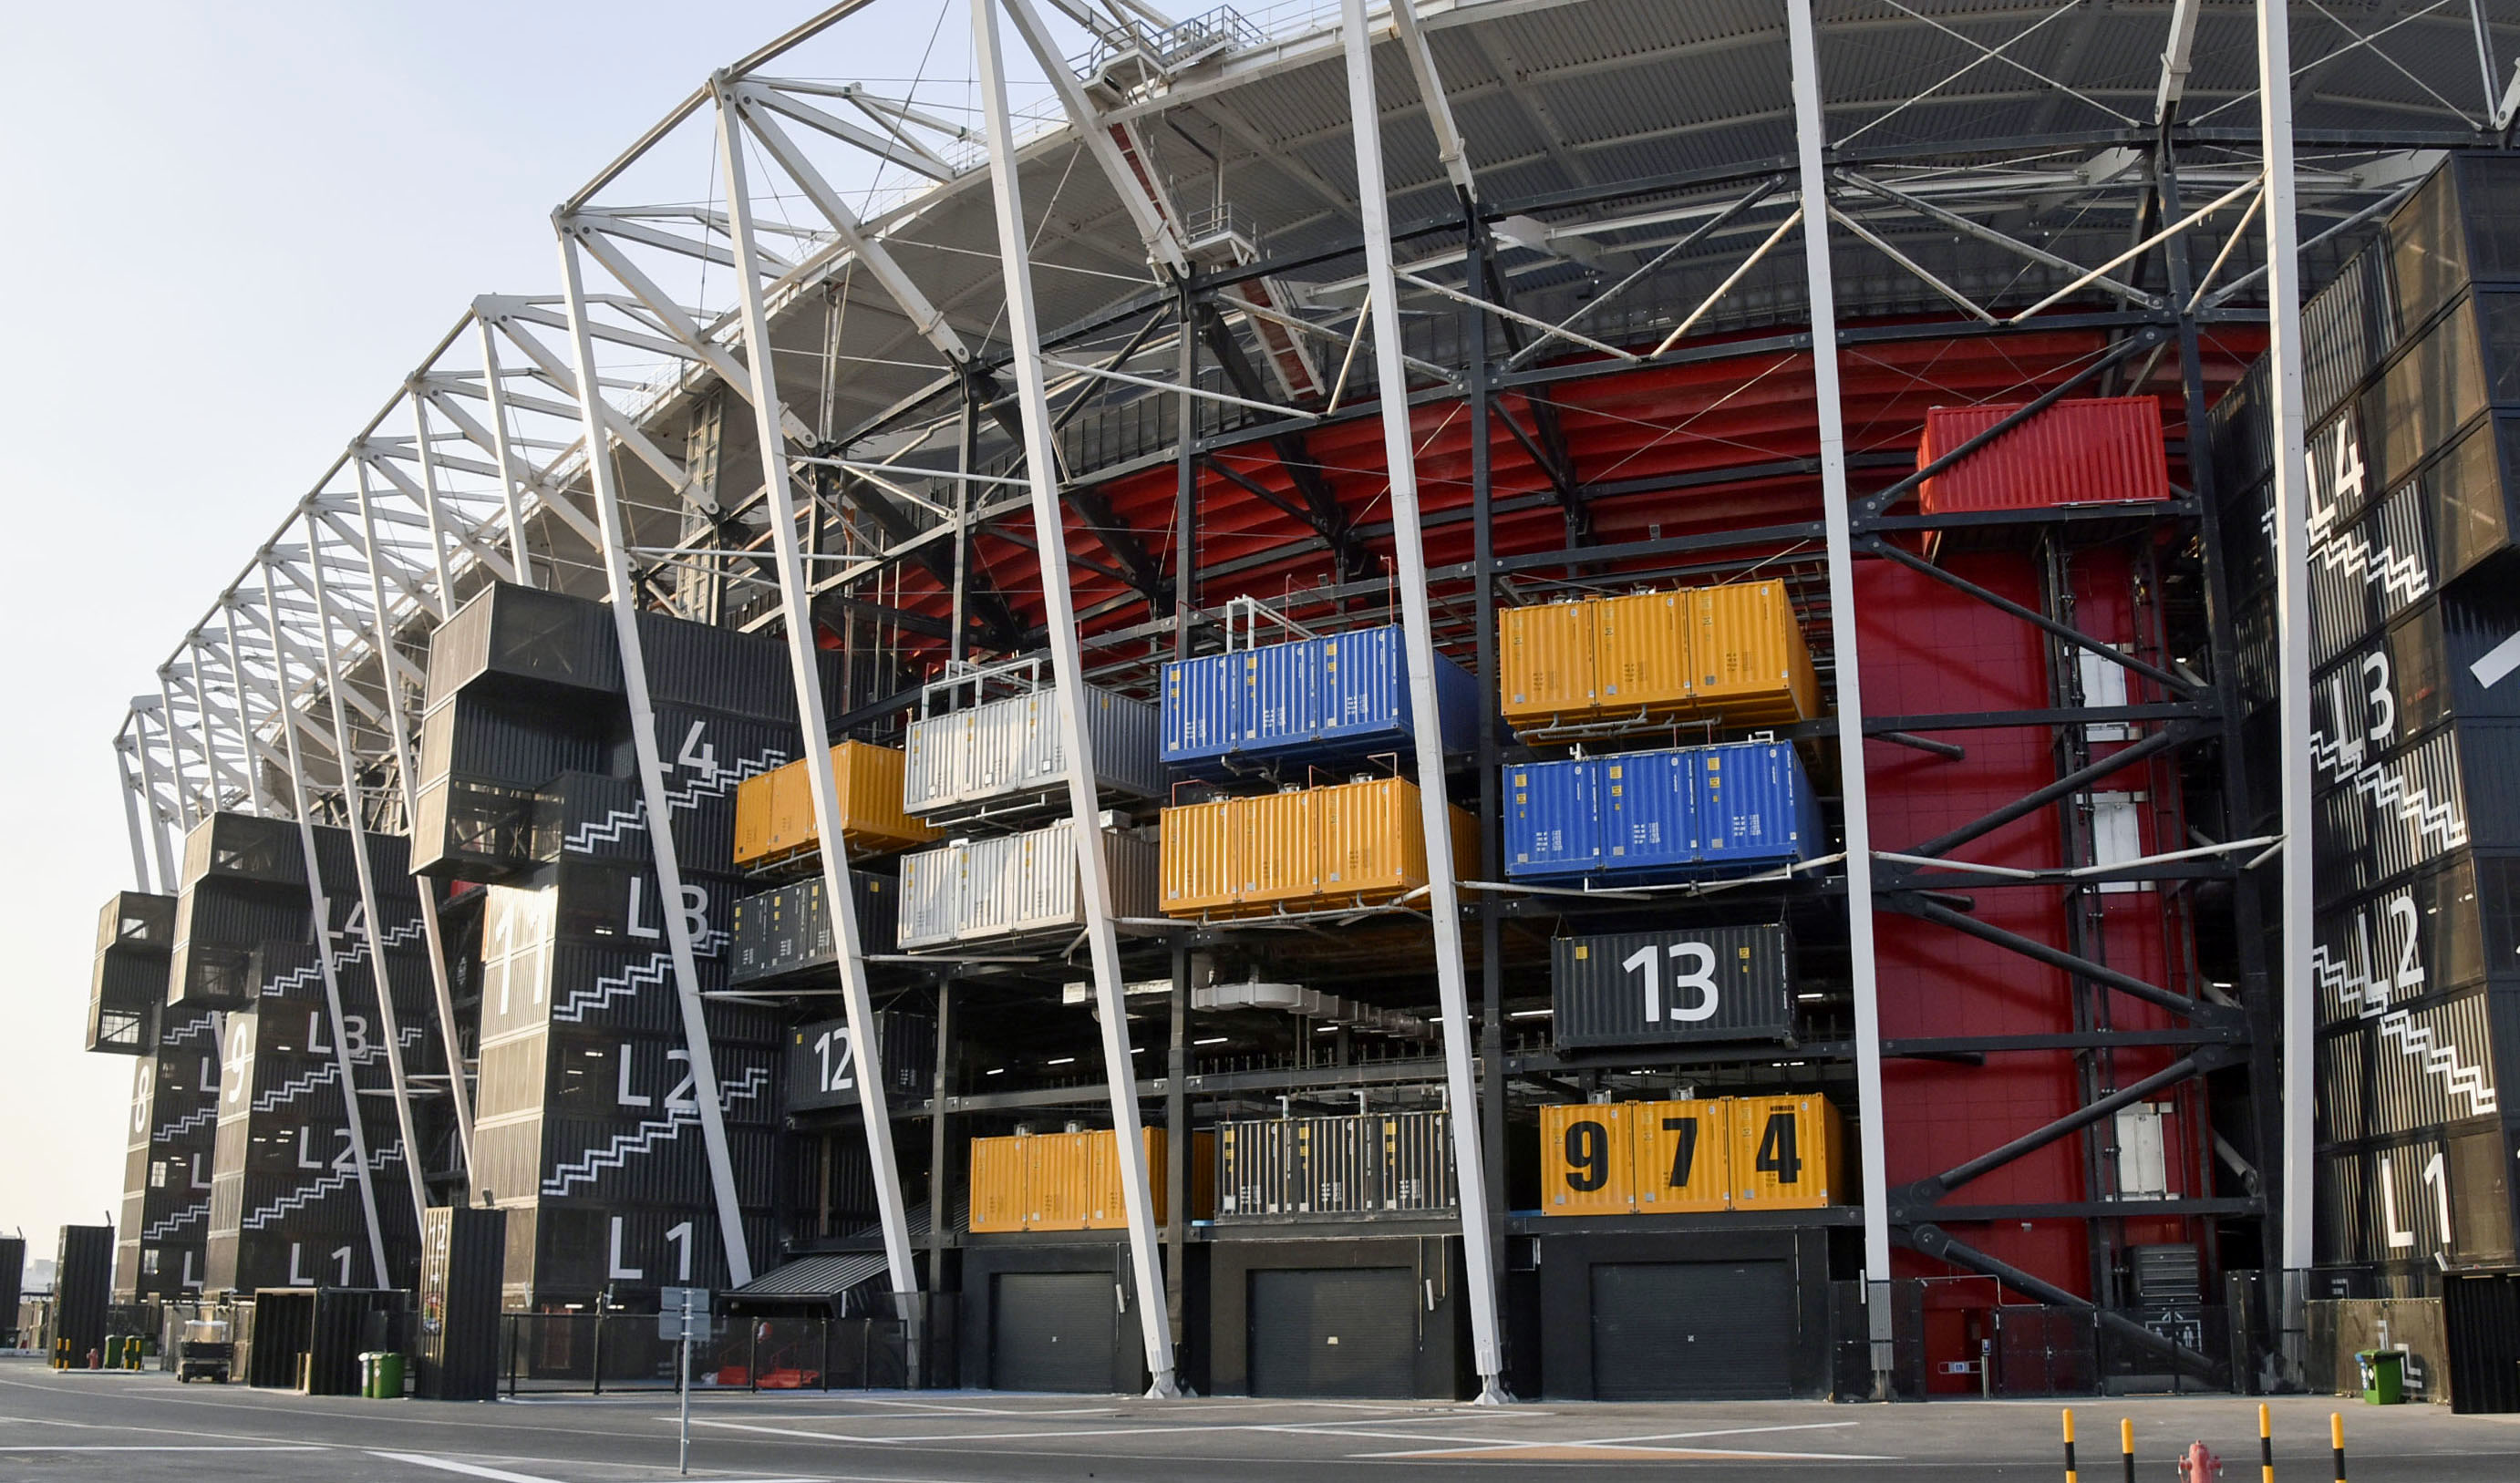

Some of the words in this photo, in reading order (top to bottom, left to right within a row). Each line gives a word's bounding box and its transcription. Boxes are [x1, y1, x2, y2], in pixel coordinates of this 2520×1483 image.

[2306, 418, 2366, 527] L4
[2332, 651, 2395, 763] L3
[648, 713, 718, 779] 4
[627, 876, 708, 943] L3
[2358, 895, 2425, 995] L2
[1622, 942, 1720, 1023] 13
[228, 1022, 247, 1104] 9
[307, 1011, 367, 1056] L3
[814, 1026, 855, 1093] 12
[134, 1064, 150, 1134] 8
[617, 1044, 698, 1108] L2
[298, 1126, 357, 1170] L2
[2381, 1151, 2452, 1248] L1
[289, 1242, 352, 1287] L1
[609, 1216, 692, 1281] L1
